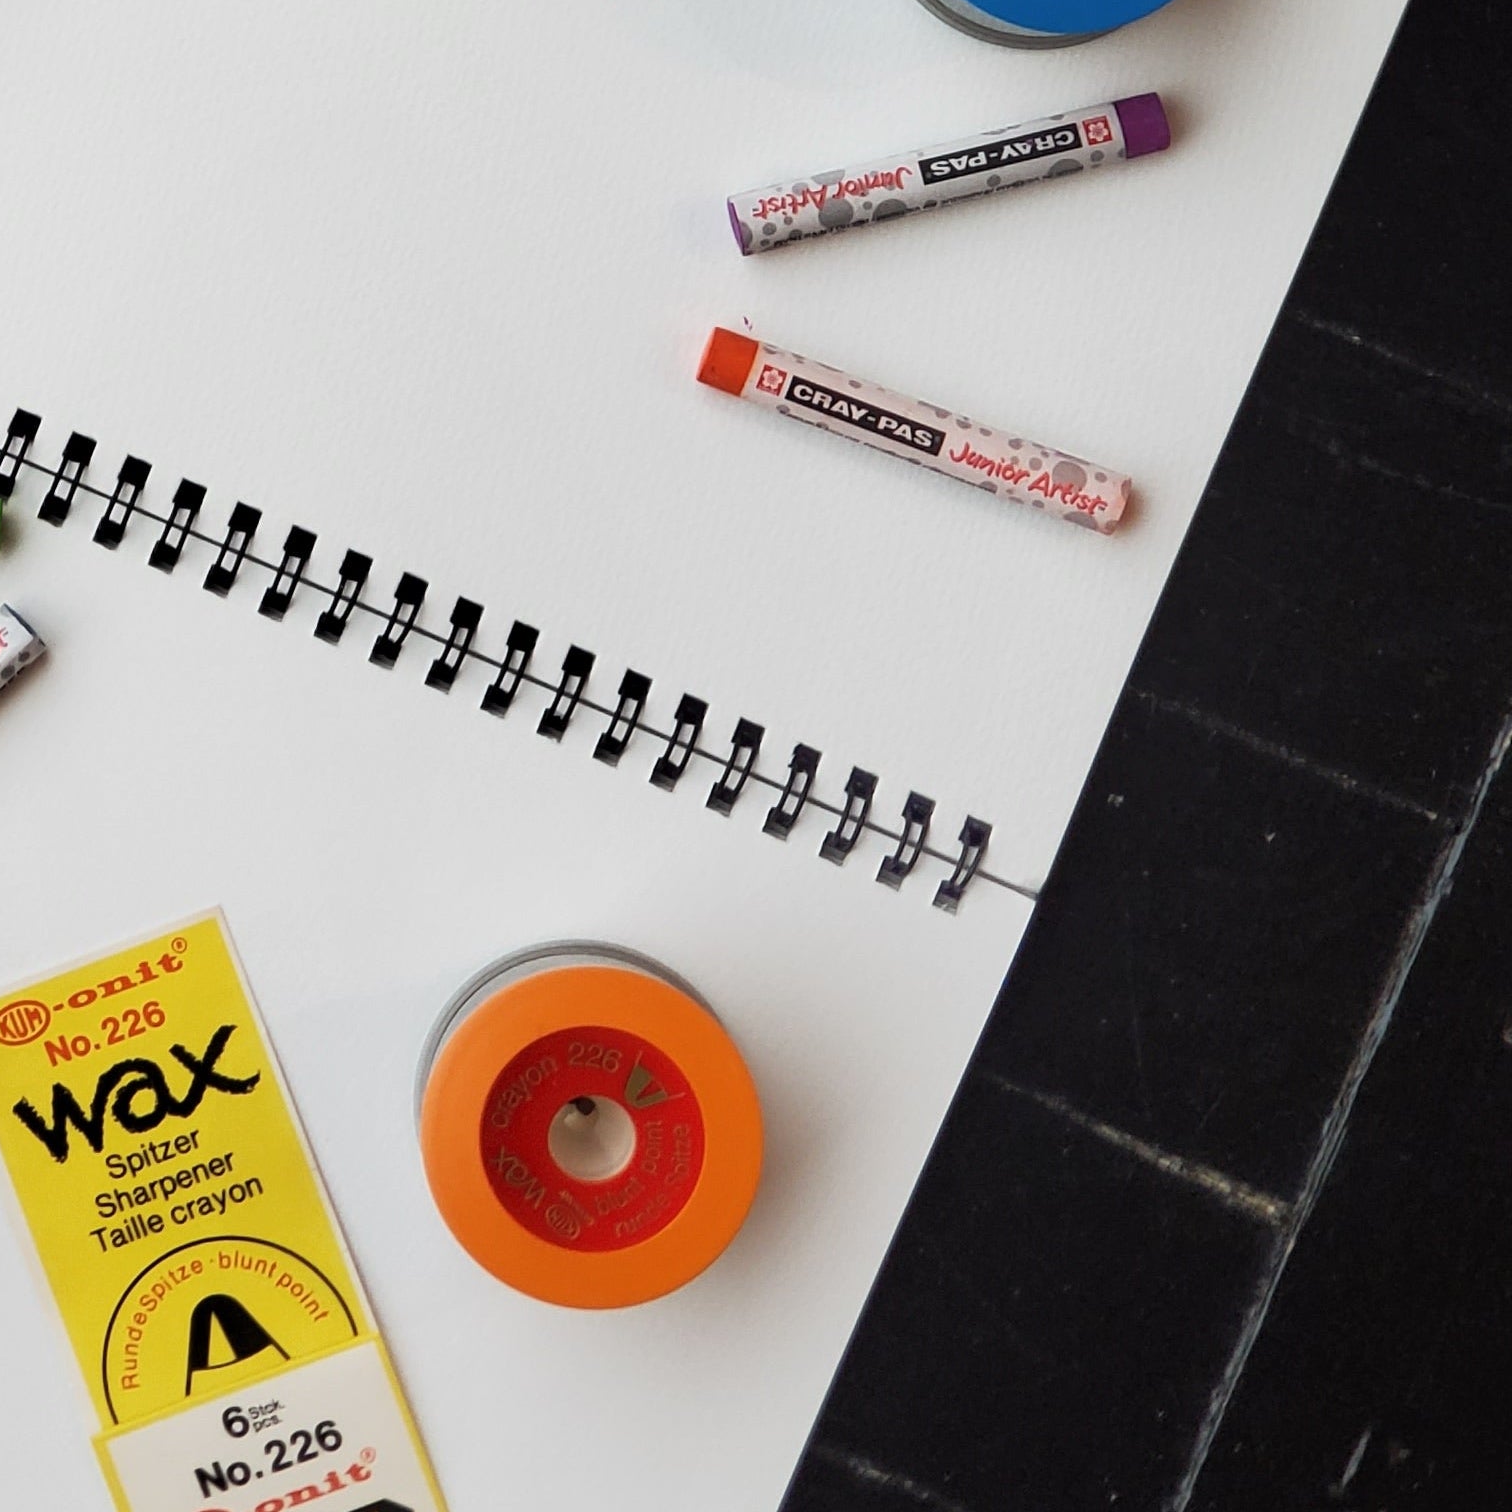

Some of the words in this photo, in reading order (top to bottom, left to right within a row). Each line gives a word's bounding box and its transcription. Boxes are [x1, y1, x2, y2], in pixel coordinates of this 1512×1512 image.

[831, 167, 912, 198] Junior
[930, 129, 1075, 176] CRAY-PAS
[757, 183, 829, 219] Artist
[792, 384, 933, 448] CRAY-PAS
[949, 441, 1030, 485] Junior
[1027, 472, 1106, 515] Artist
[12, 1024, 261, 1164] wax
[491, 1055, 559, 1129] crayon
[567, 1042, 623, 1073] 226
[95, 1152, 234, 1218] Sharpener
[105, 1129, 199, 1179] Spitzer
[90, 1211, 165, 1252] Taille
[170, 1176, 264, 1225] crayon
[218, 1250, 278, 1279] blunt
[275, 1272, 329, 1322] point
[222, 1406, 250, 1438] 6
